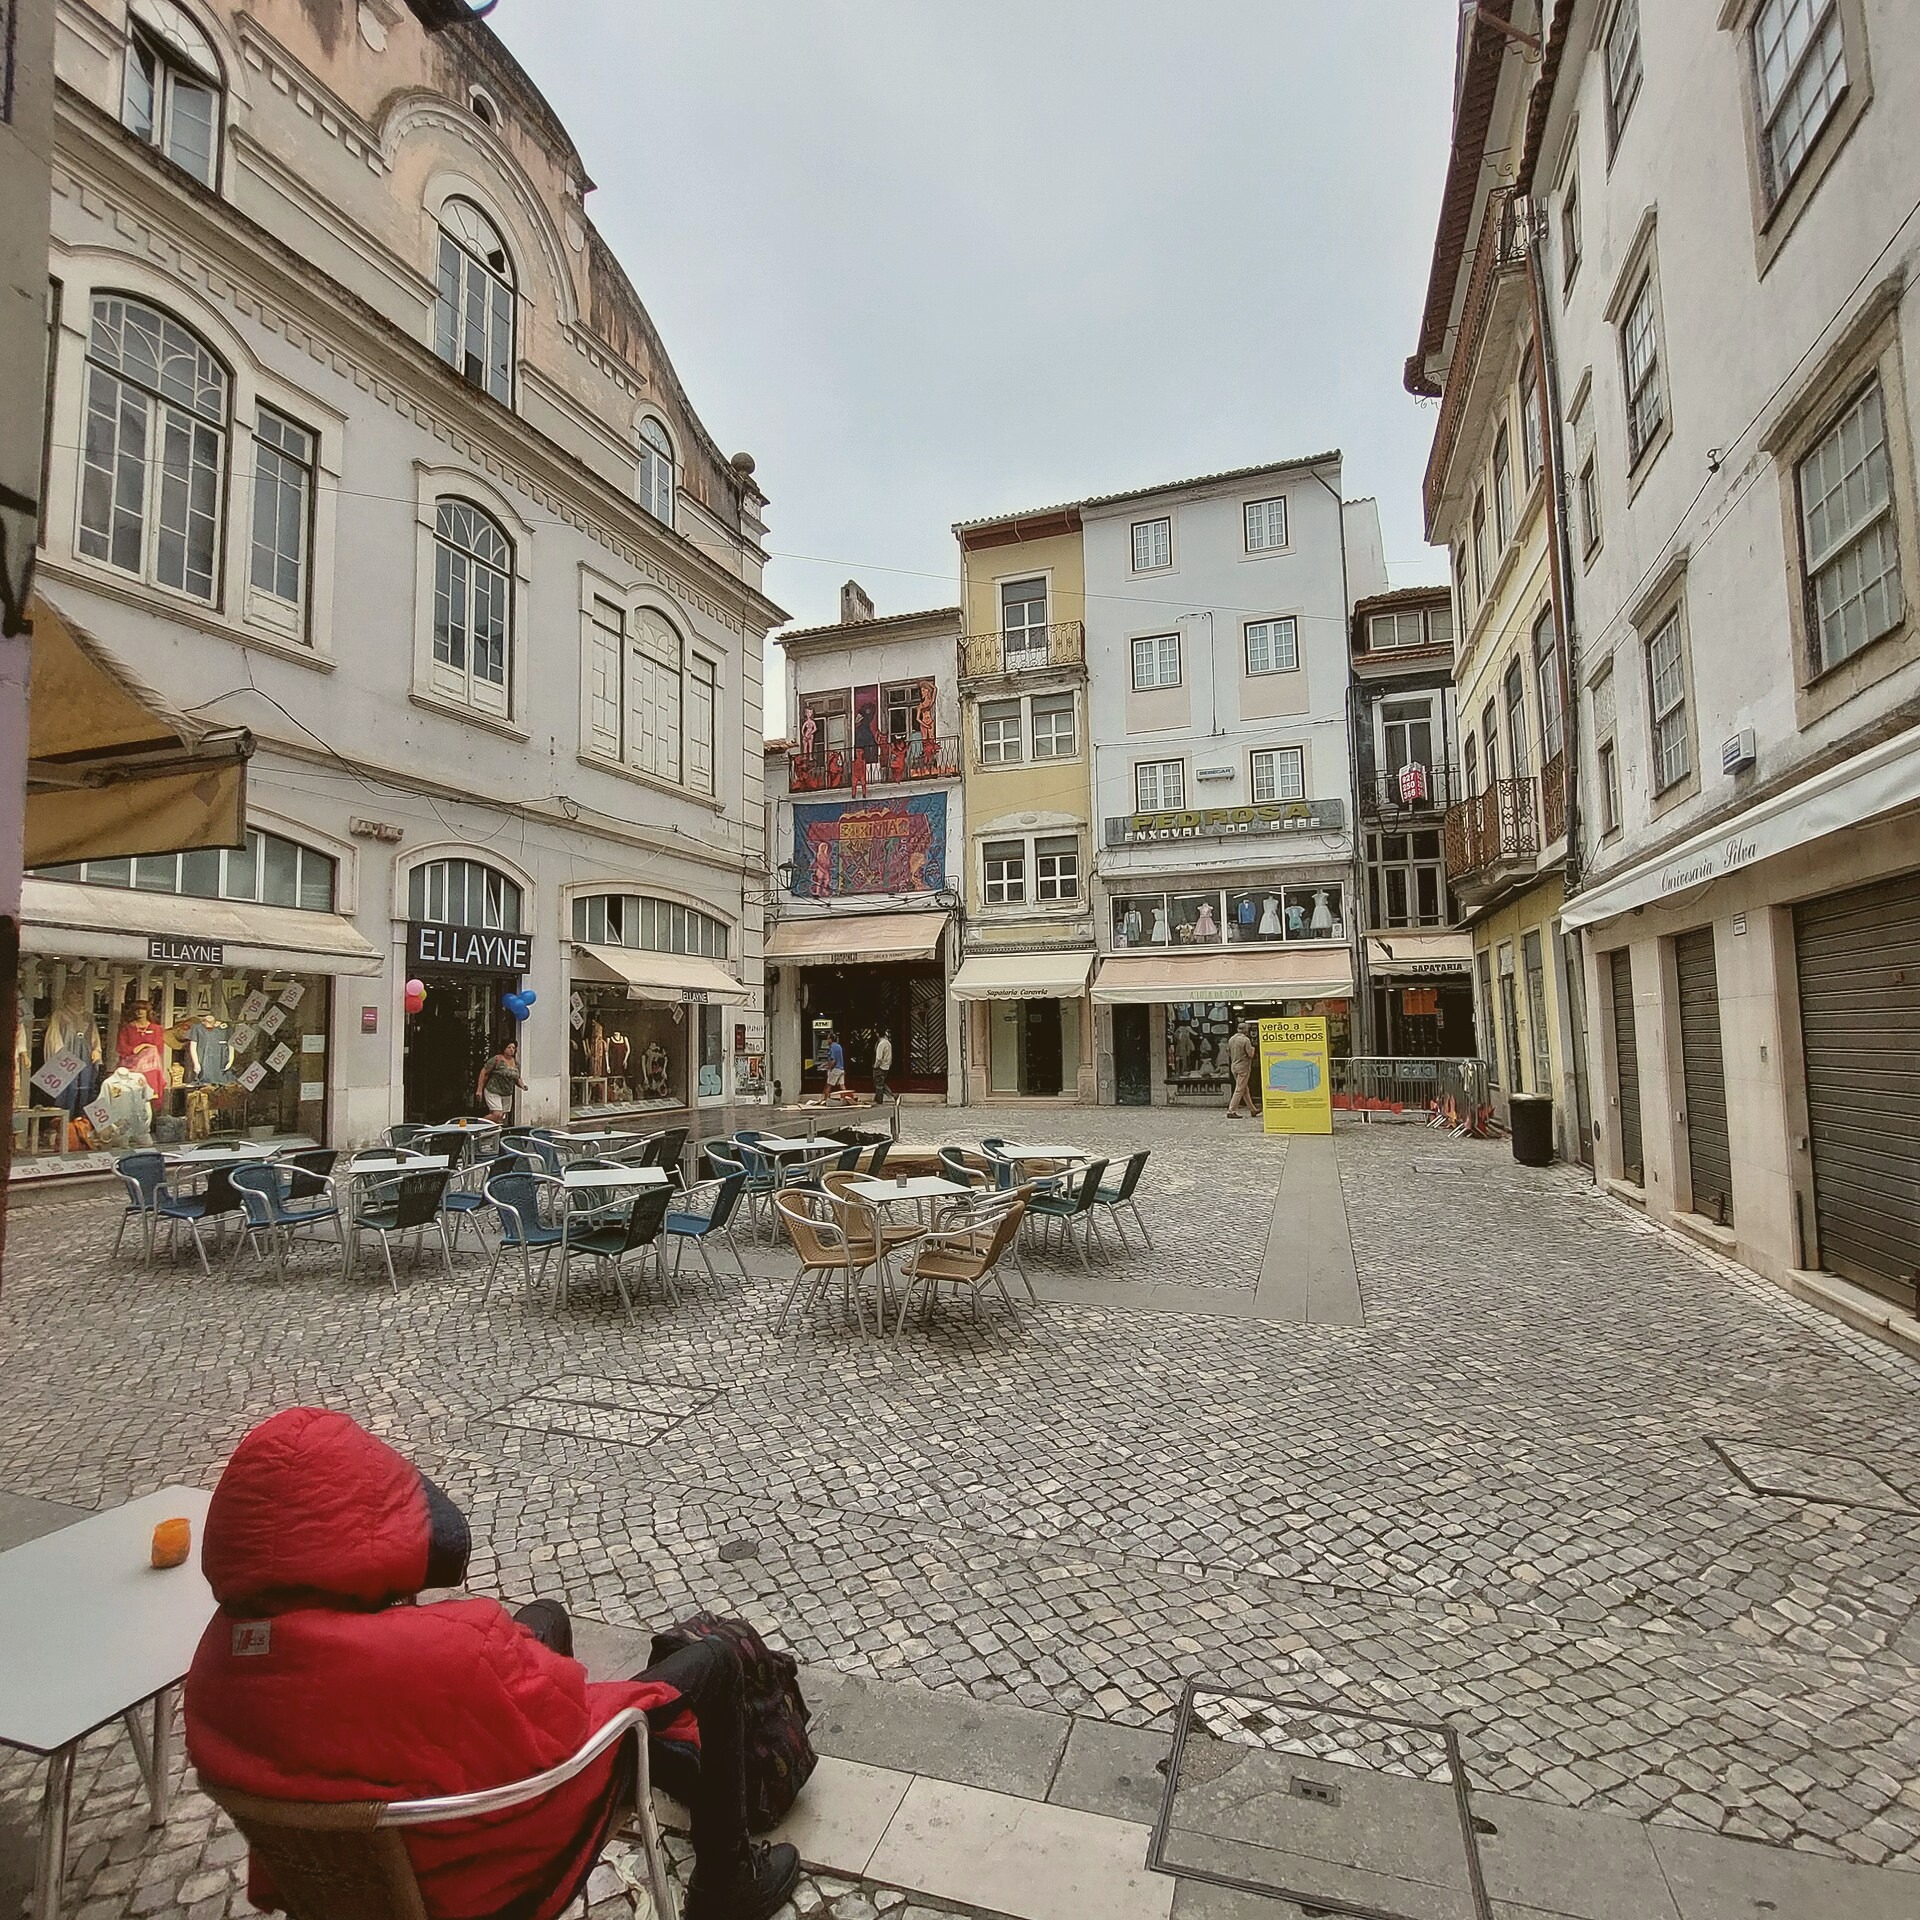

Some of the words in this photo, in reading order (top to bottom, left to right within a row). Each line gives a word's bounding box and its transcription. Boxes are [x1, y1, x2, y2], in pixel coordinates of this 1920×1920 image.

[1402, 780, 1416, 791] 250
[1132, 804, 1312, 831] PEDROSA
[1124, 826, 1204, 842] ENXOVAL
[1226, 823, 1248, 833] DO
[1724, 837, 1758, 869] Silva
[151, 942, 221, 962] ELLAYNE
[419, 928, 527, 969] ELLAYNE
[1411, 963, 1463, 972] SAPATARIA
[682, 991, 708, 1002] ELLAYNE
[986, 989, 1018, 997] Sapataria
[1262, 1022, 1289, 1030] verão
[1262, 1033, 1283, 1041] dois
[1285, 1032, 1324, 1042] tempos
